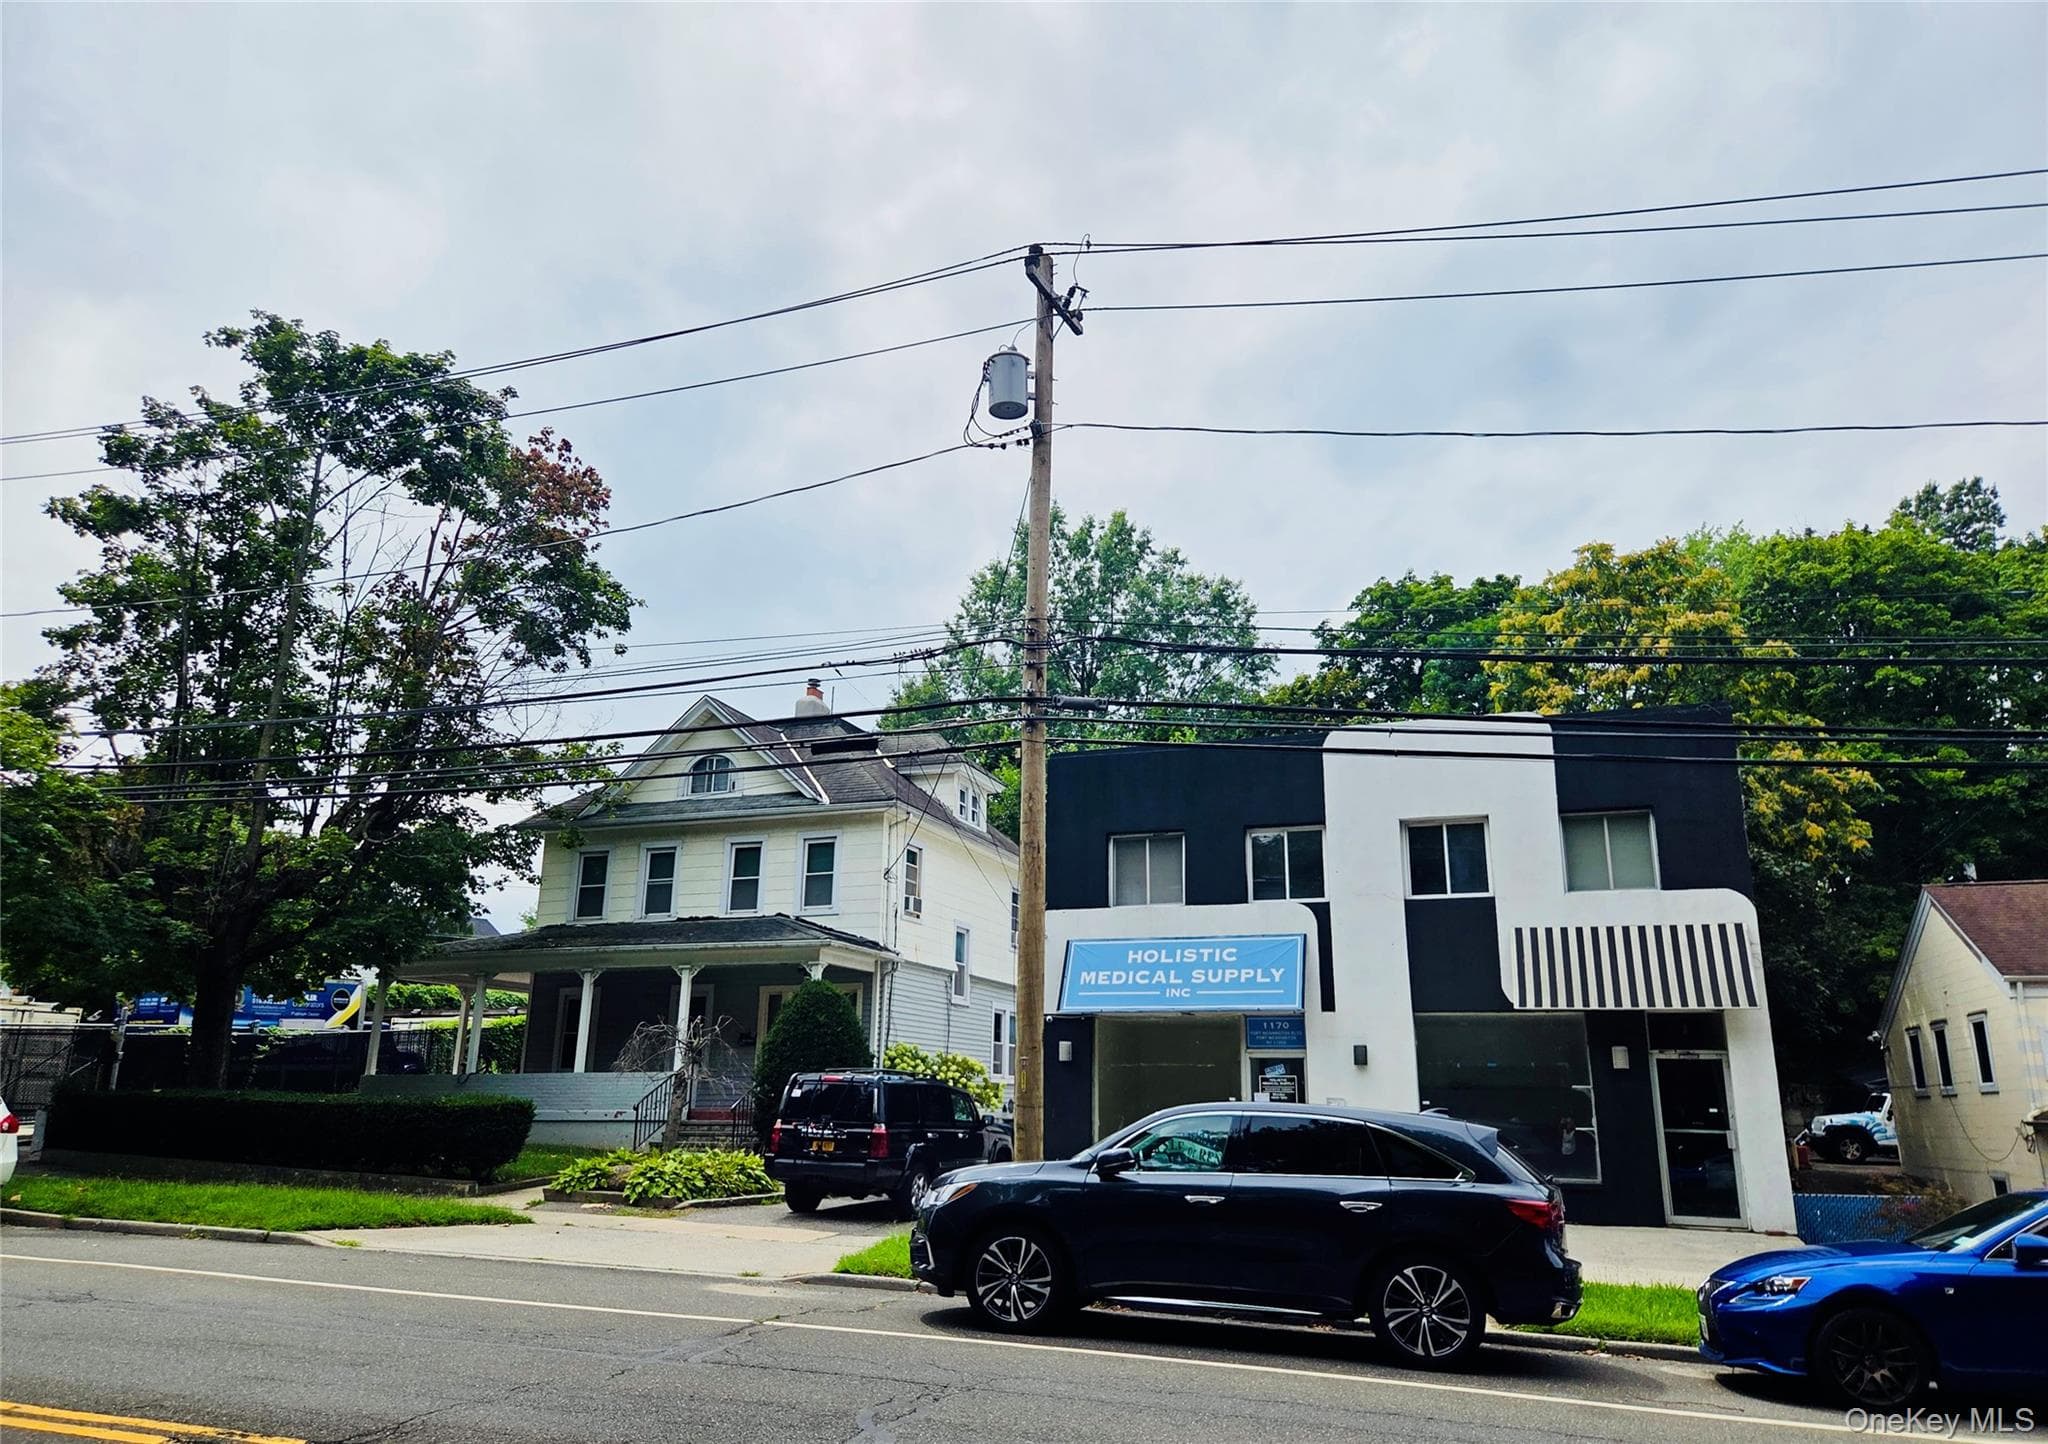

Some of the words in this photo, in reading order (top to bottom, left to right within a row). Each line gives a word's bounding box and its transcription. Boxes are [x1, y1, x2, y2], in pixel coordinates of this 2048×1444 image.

[1127, 947, 1238, 964] HOLISTIC
[1080, 970, 1183, 985] MEDICAL
[1191, 968, 1286, 984] SUPPLY
[1165, 988, 1191, 998] INC
[1263, 1021, 1290, 1030] 1170
